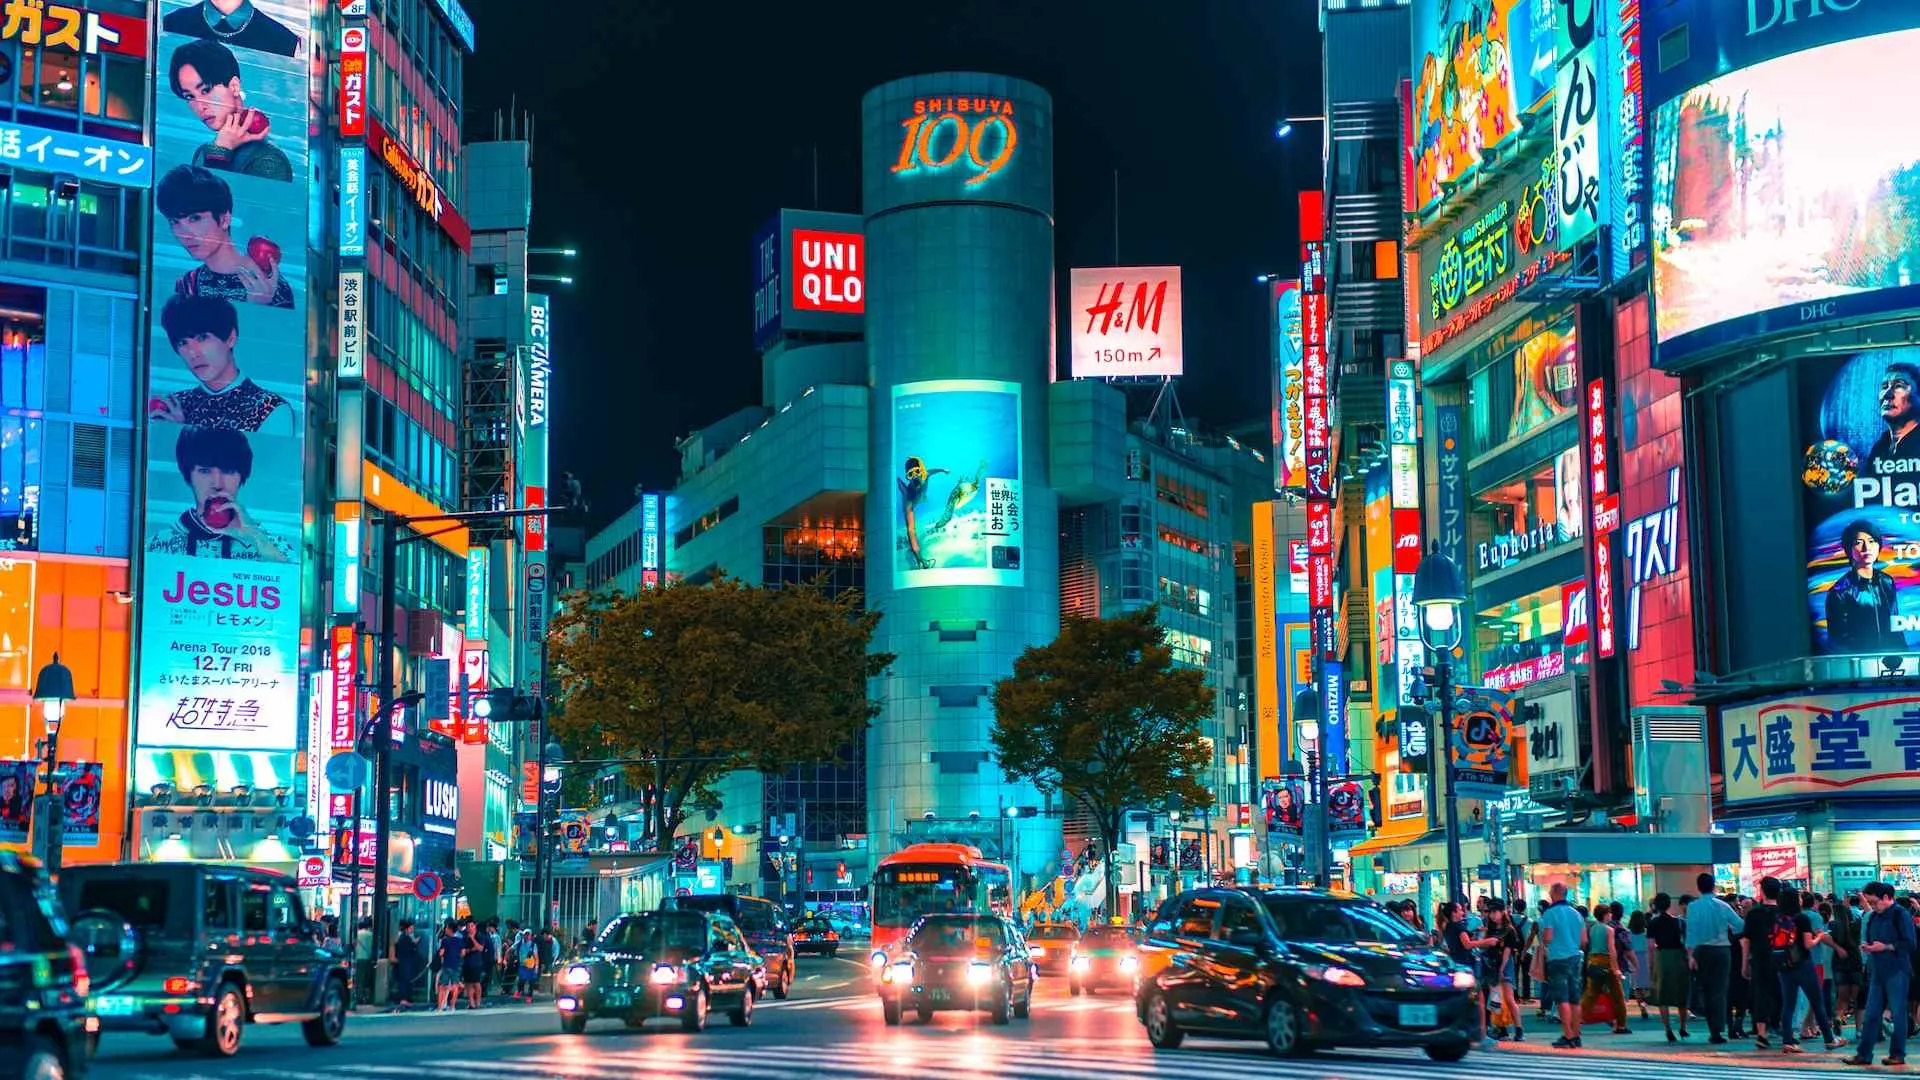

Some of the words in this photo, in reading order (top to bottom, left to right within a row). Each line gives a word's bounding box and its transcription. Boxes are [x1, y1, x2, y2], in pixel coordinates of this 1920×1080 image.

[2, 0, 119, 54] ガスト
[346, 74, 361, 125] ガスト
[914, 97, 1014, 115] SHIBUYA
[891, 113, 1017, 186] 109
[802, 241, 857, 272] UNI
[755, 275, 780, 333] PRIME
[802, 273, 862, 305] QLO
[344, 278, 358, 369] 渋谷駅前ビル
[531, 305, 545, 337] BIC
[1086, 280, 1167, 337] H&M
[1800, 302, 1836, 321] DHC
[1095, 348, 1143, 363] 150m
[531, 343, 552, 426] CAMERA
[1854, 477, 1920, 509] Pla
[1397, 534, 1418, 548] JTB
[1479, 518, 1554, 569] Euphoria
[163, 571, 281, 610] Jesus
[233, 573, 251, 581] NEW
[253, 574, 281, 583] SINGLE
[170, 641, 206, 653] Arena
[212, 643, 237, 654] Tour
[241, 645, 271, 656] 2018
[193, 656, 231, 672] 12.7
[234, 663, 253, 672] FRI
[159, 673, 280, 689] さいたまスーパーアリーナ
[1328, 675, 1339, 725] MIZUHO
[1407, 720, 1426, 757] HUB
[426, 779, 458, 820] LUSH
